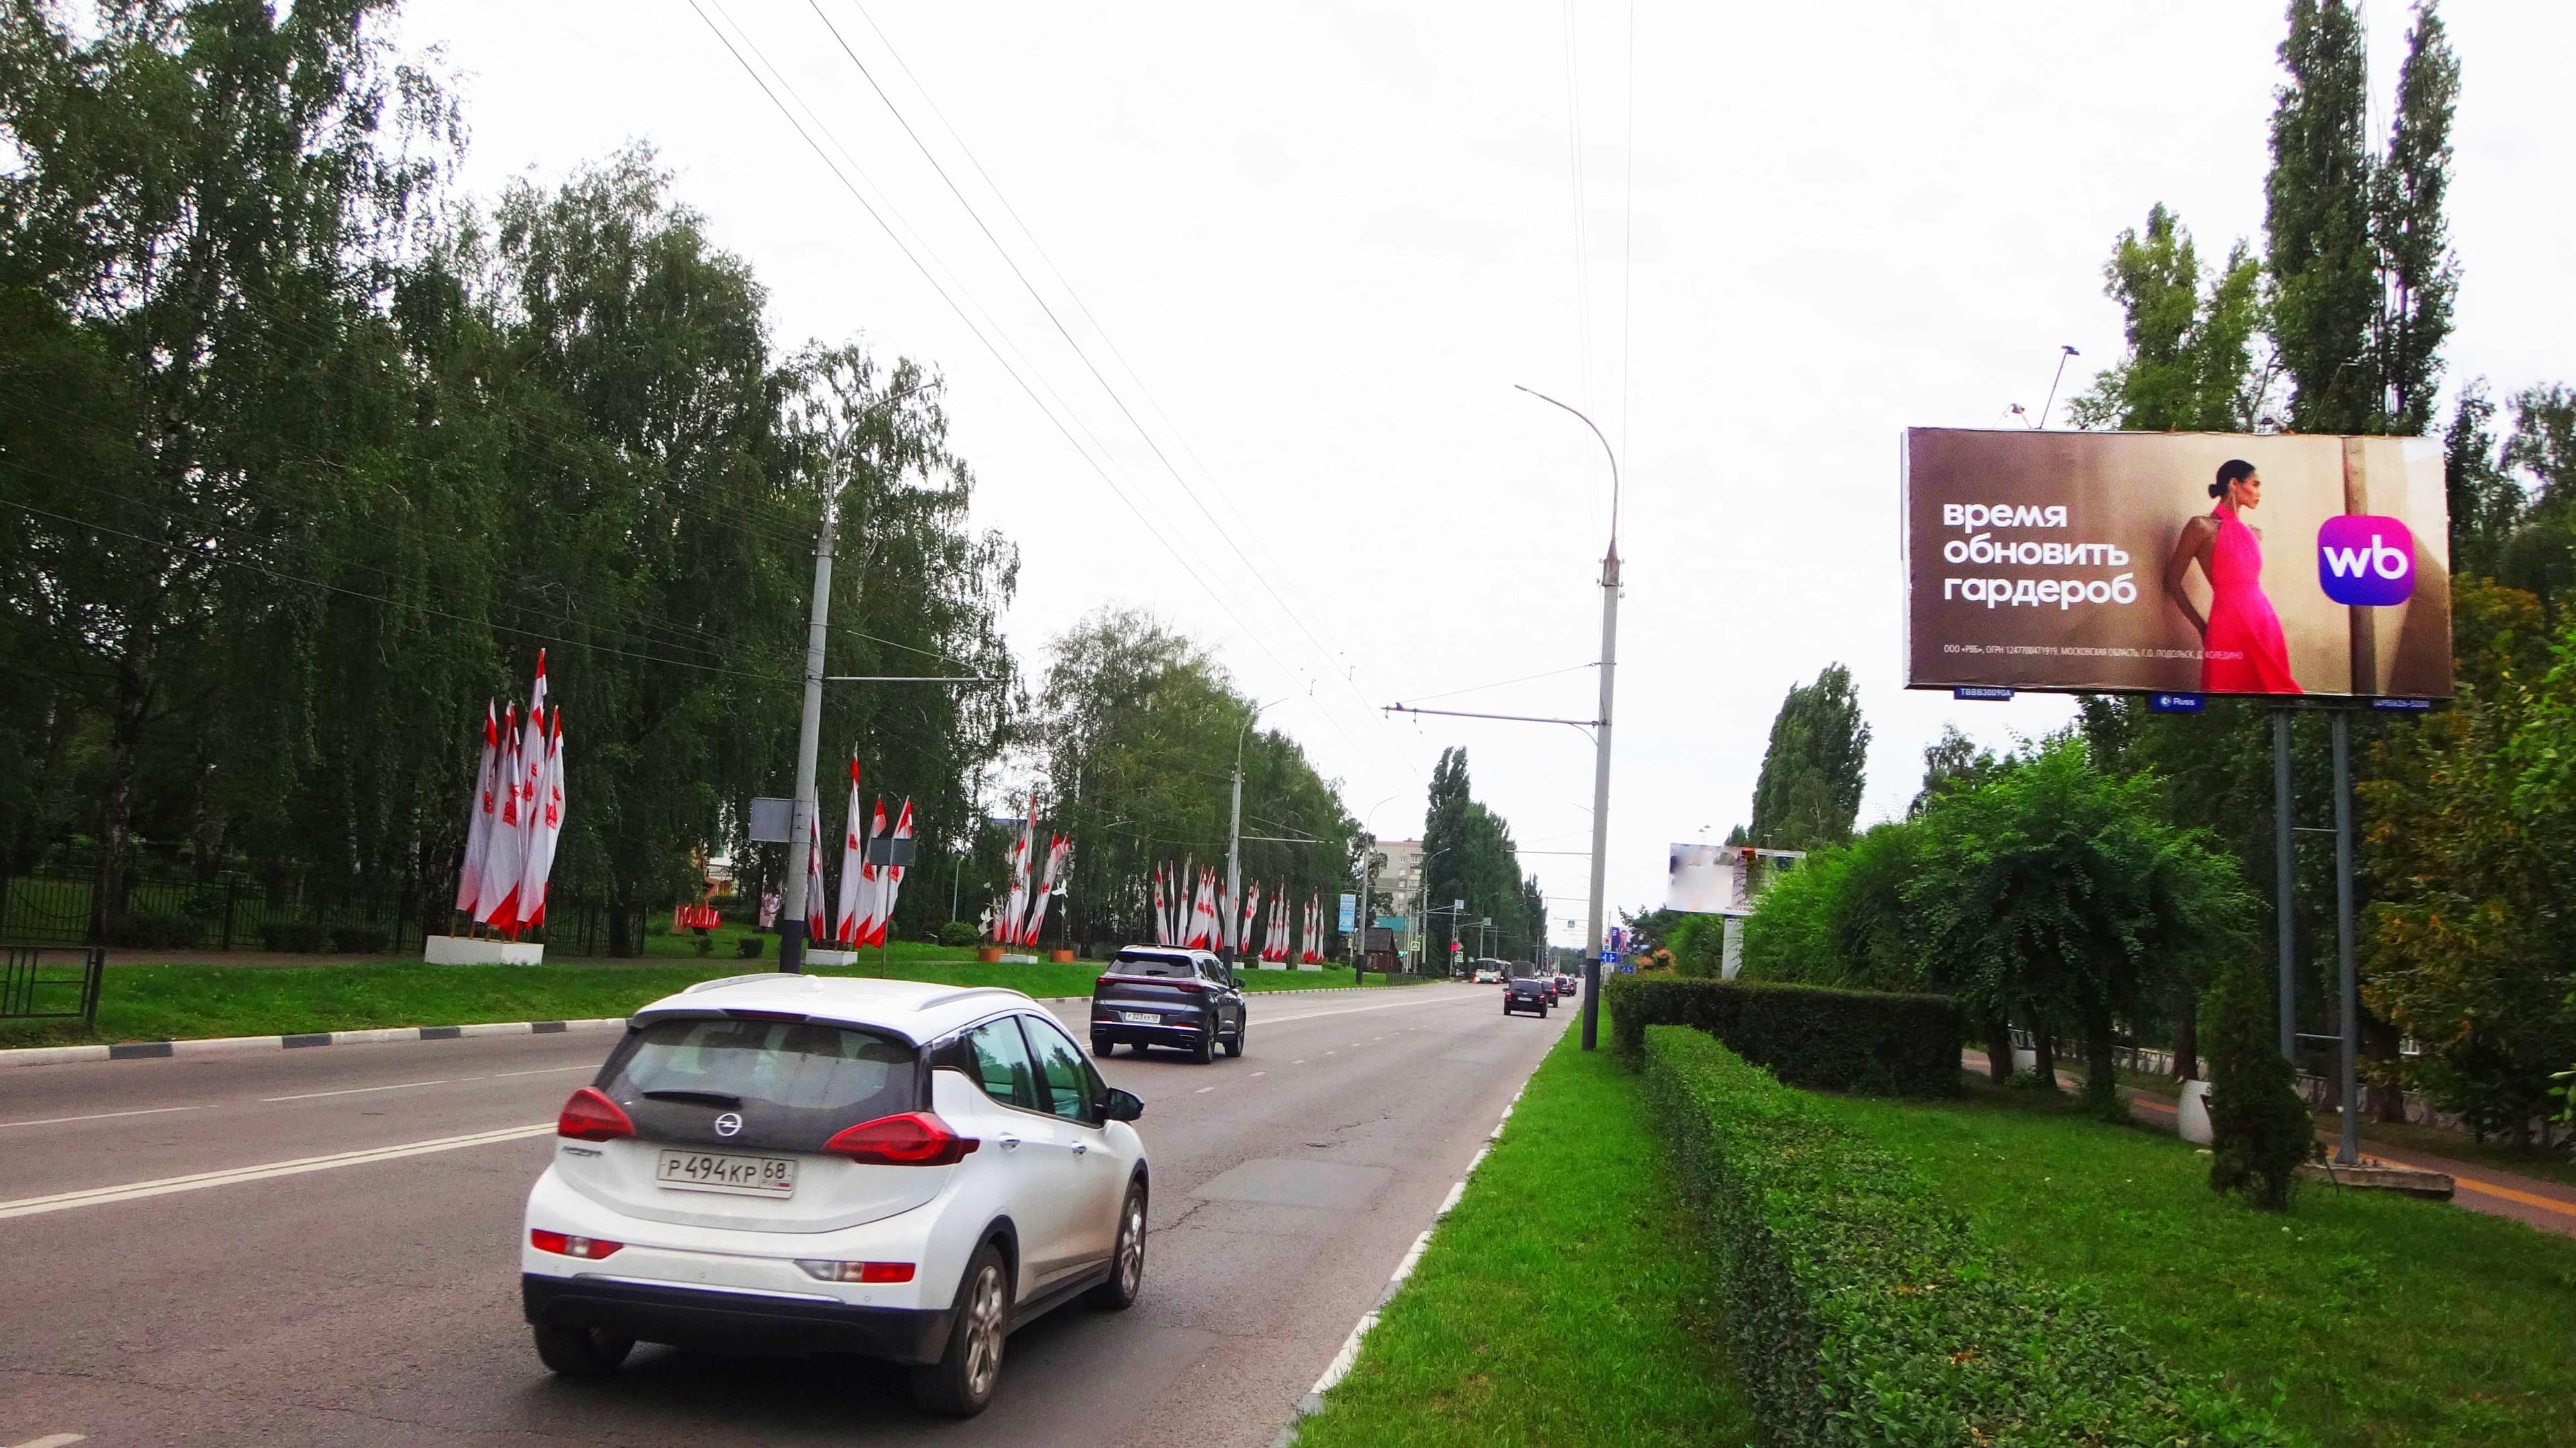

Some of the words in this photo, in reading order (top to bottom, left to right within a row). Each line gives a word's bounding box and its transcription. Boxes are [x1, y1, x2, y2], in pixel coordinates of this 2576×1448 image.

[1943, 504, 2068, 533] время
[1943, 533, 2129, 565] обновить
[2322, 534, 2408, 579] wb
[1944, 573, 2137, 610] гардероб
[1943, 645, 1960, 653] ООО
[1986, 645, 2004, 654] ОГРН
[2173, 698, 2196, 706] Russ
[667, 1156, 757, 1183] Р494КР
[763, 1162, 786, 1179] 68
